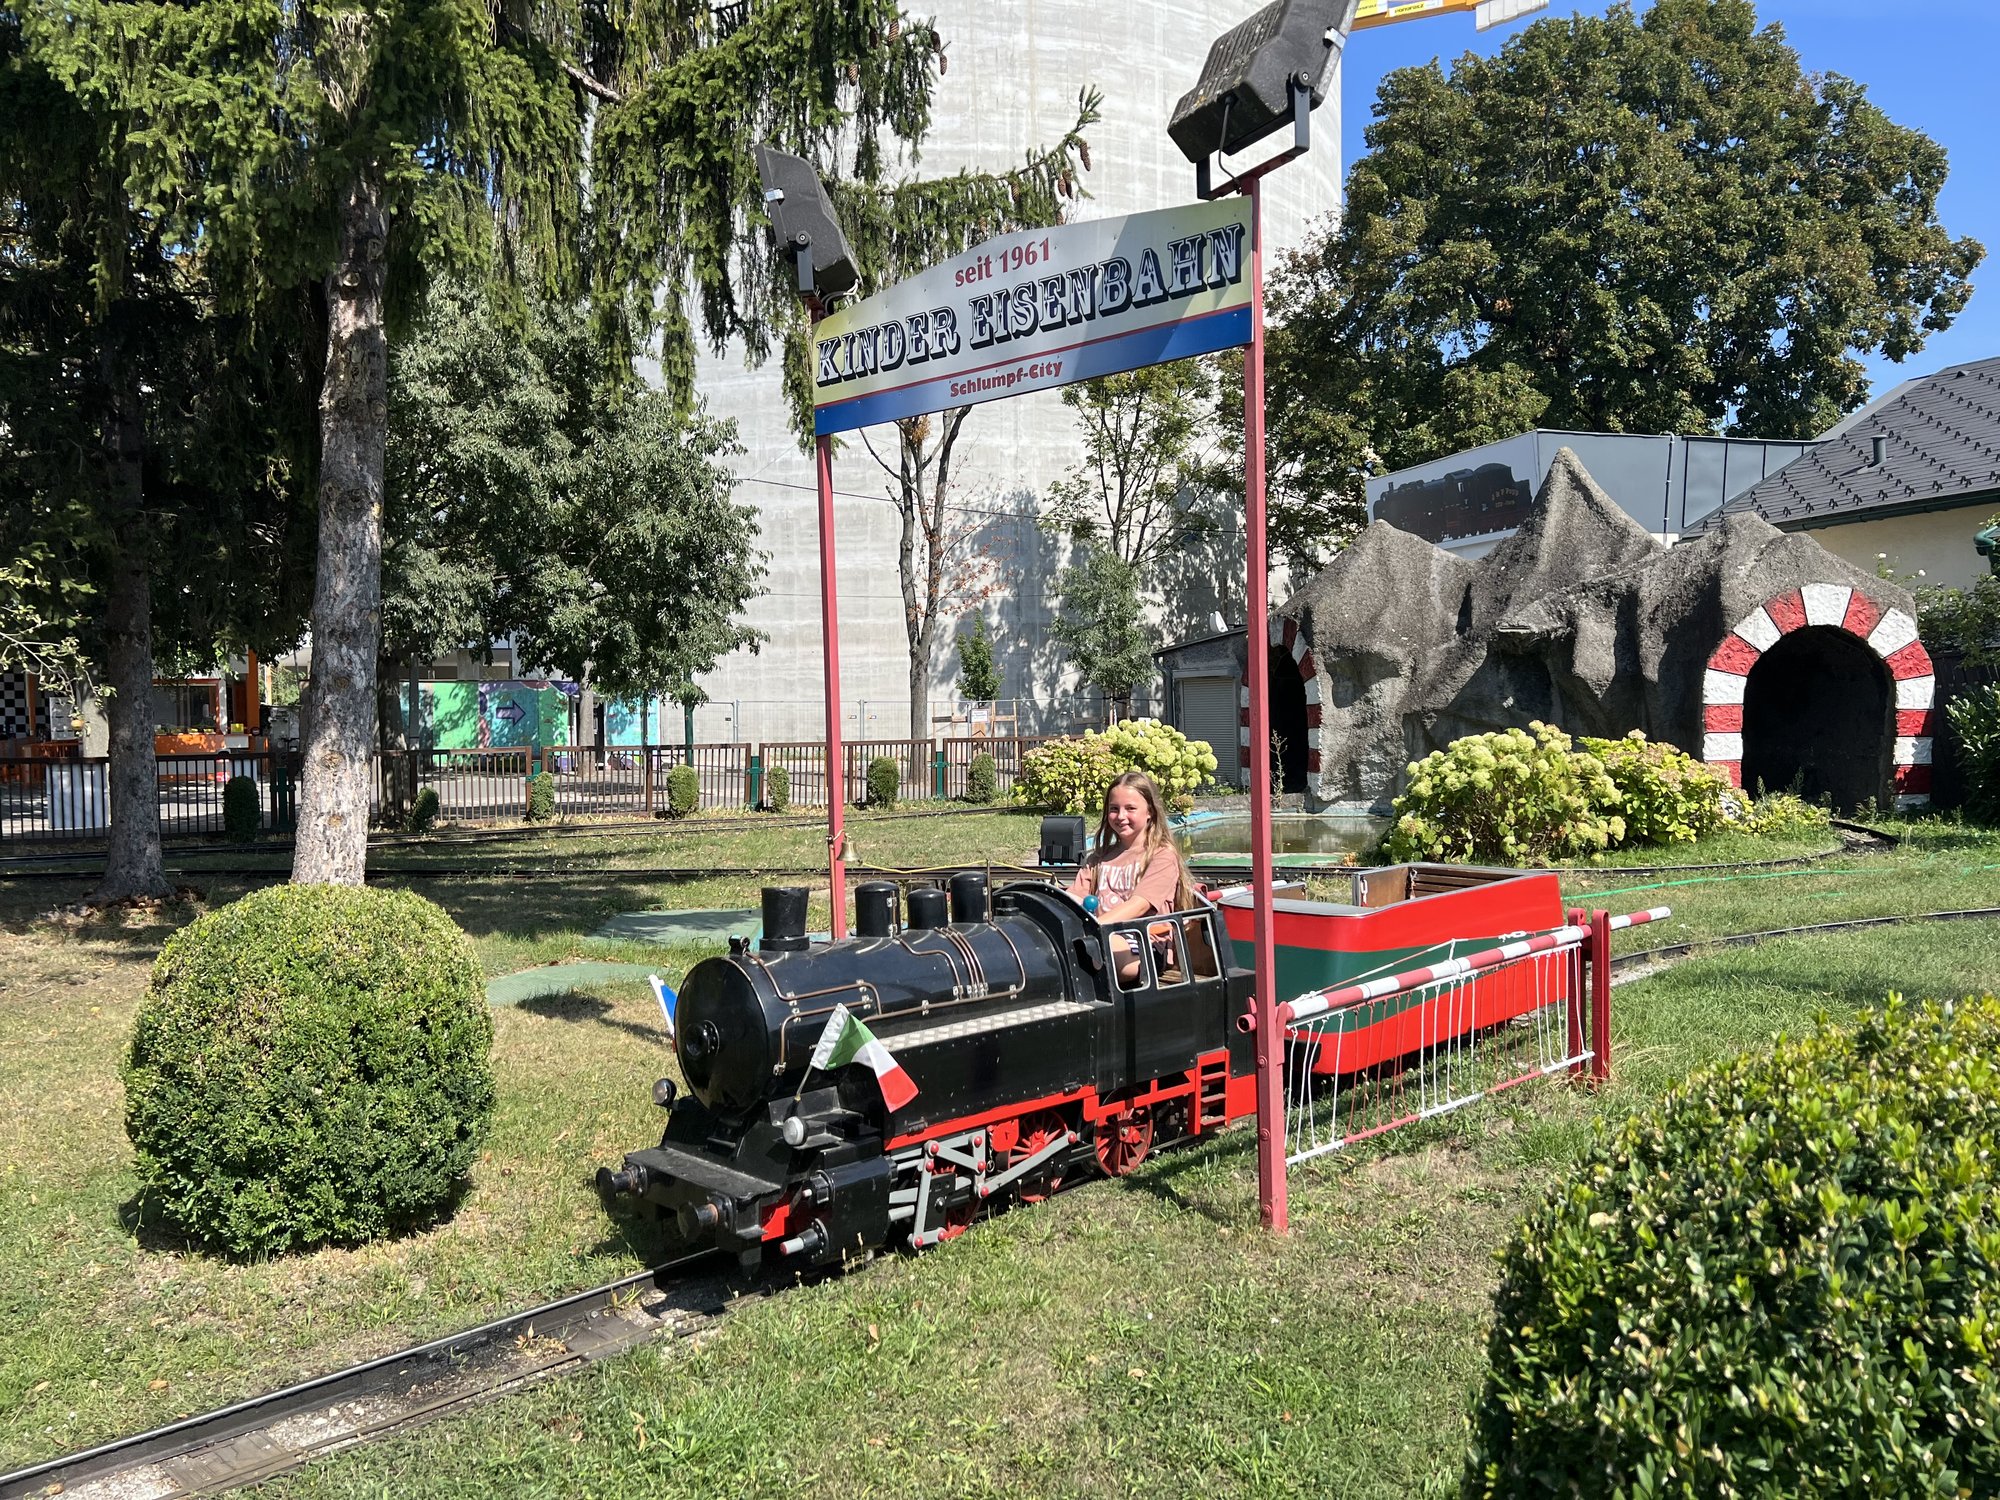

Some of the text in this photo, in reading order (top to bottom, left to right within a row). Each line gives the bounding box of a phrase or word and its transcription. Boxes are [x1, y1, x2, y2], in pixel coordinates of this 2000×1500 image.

[955, 237, 1050, 287] seit 1961
[816, 223, 1245, 388] KINDER EISENBAHN
[950, 361, 1062, 397] Schlumpf-City
